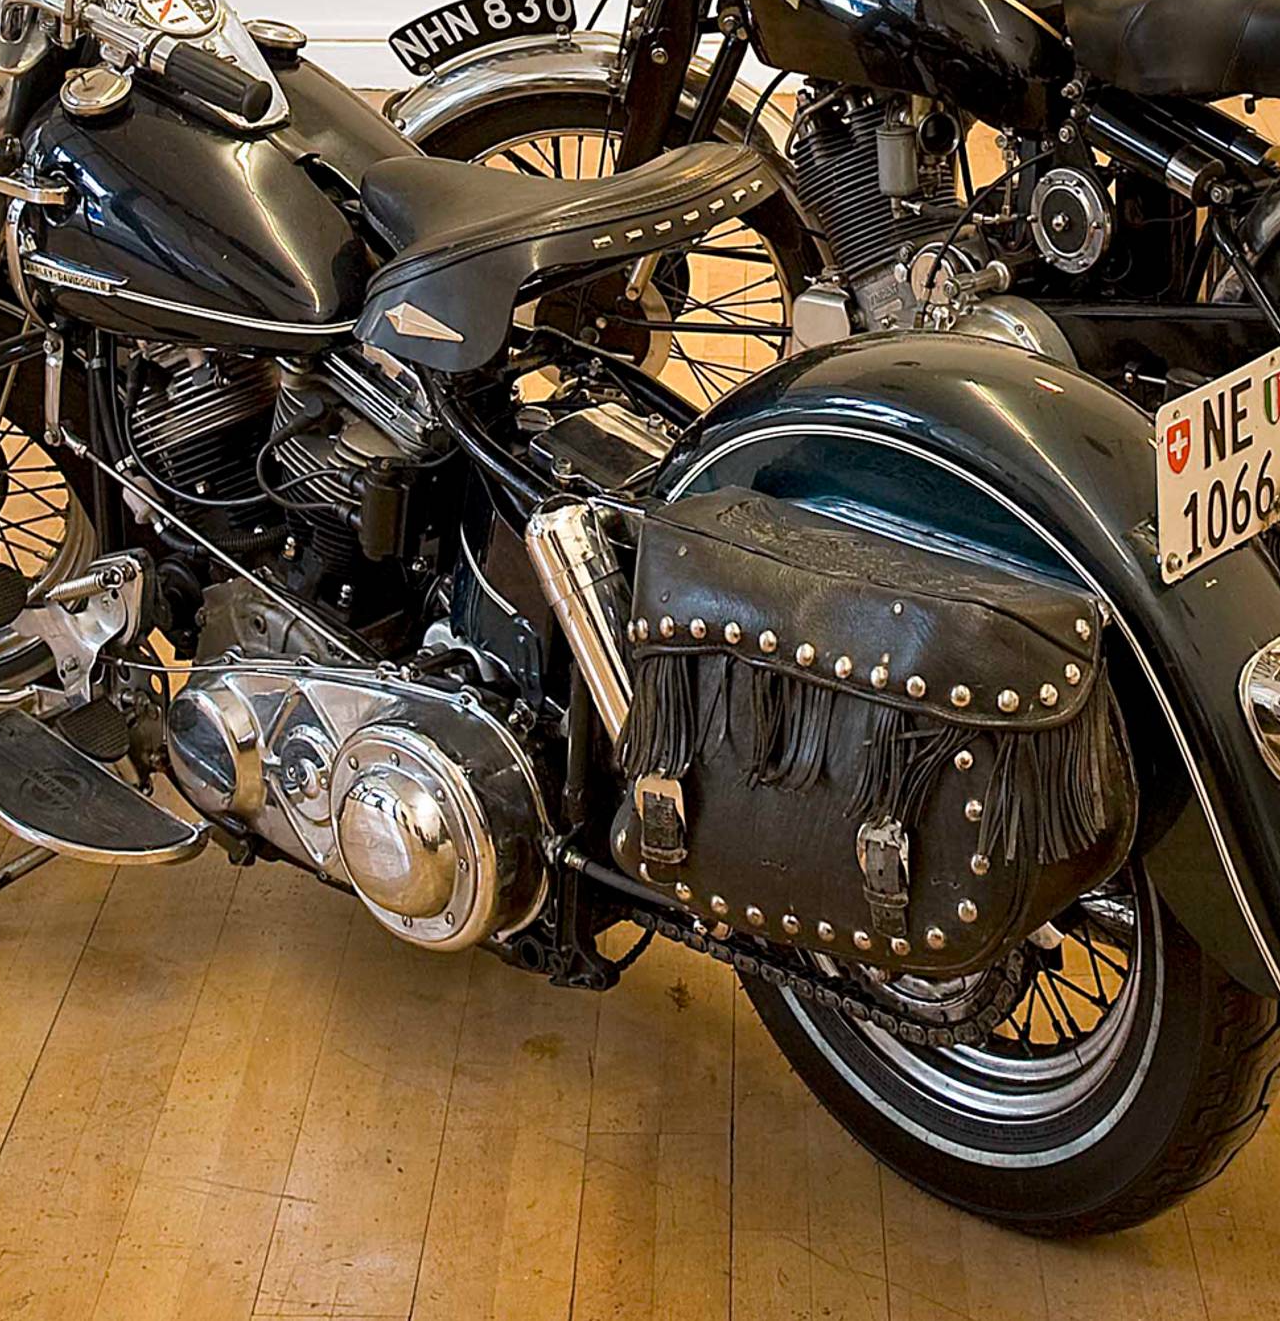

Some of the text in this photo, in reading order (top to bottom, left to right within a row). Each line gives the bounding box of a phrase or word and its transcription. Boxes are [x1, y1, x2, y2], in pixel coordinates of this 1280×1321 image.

[391, 3, 481, 68] NHN
[1202, 376, 1254, 470] NE
[1183, 449, 1275, 563] 1066
